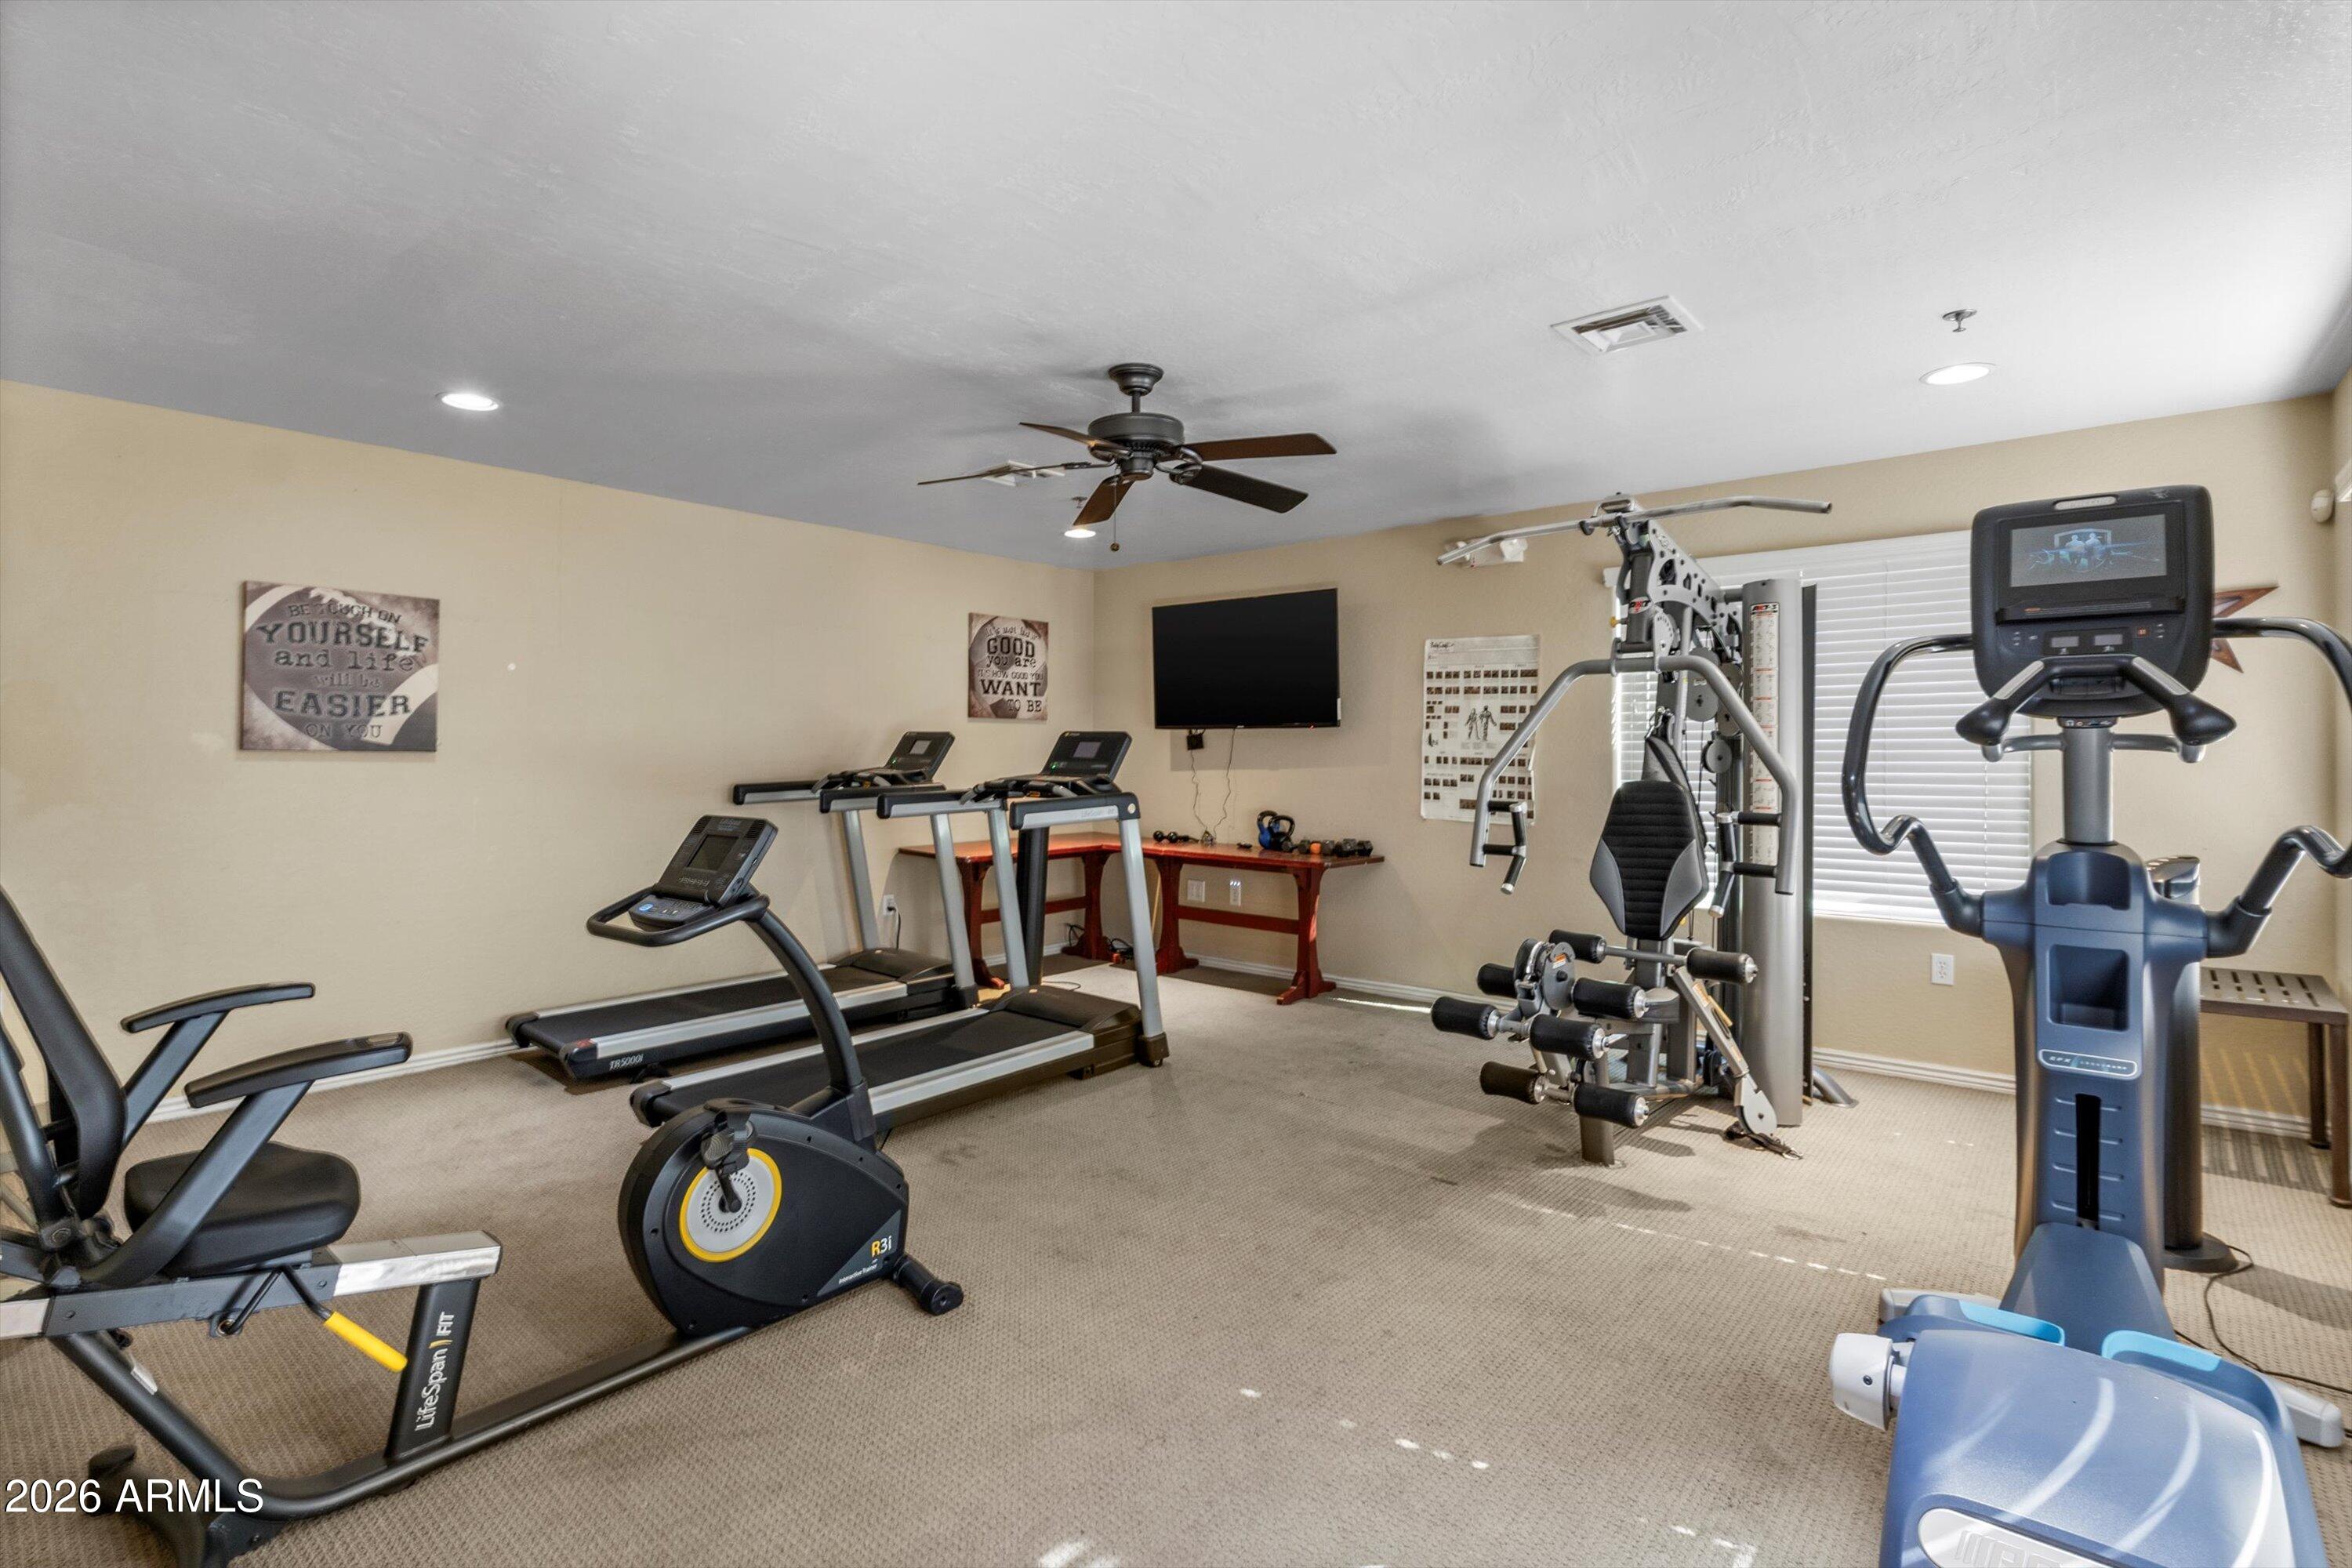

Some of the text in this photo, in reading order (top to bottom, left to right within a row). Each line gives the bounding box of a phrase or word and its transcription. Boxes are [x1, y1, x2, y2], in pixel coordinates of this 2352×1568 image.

[289, 604, 310, 618] BE
[378, 609, 402, 624] ON
[256, 621, 429, 652] YOURSELF
[987, 636, 1035, 658] GOOD
[274, 649, 415, 672] and life
[986, 655, 1036, 668] you are
[314, 673, 383, 688] will be
[993, 670, 1008, 679] HOW
[1030, 672, 1044, 681] YOU
[980, 678, 1041, 697] WANT
[275, 691, 412, 717] EASIER
[1007, 699, 1042, 712] TO BE
[305, 724, 383, 739] ON YOU
[871, 1235, 892, 1257] R3i
[415, 1312, 455, 1432] LifeSpan FIT
